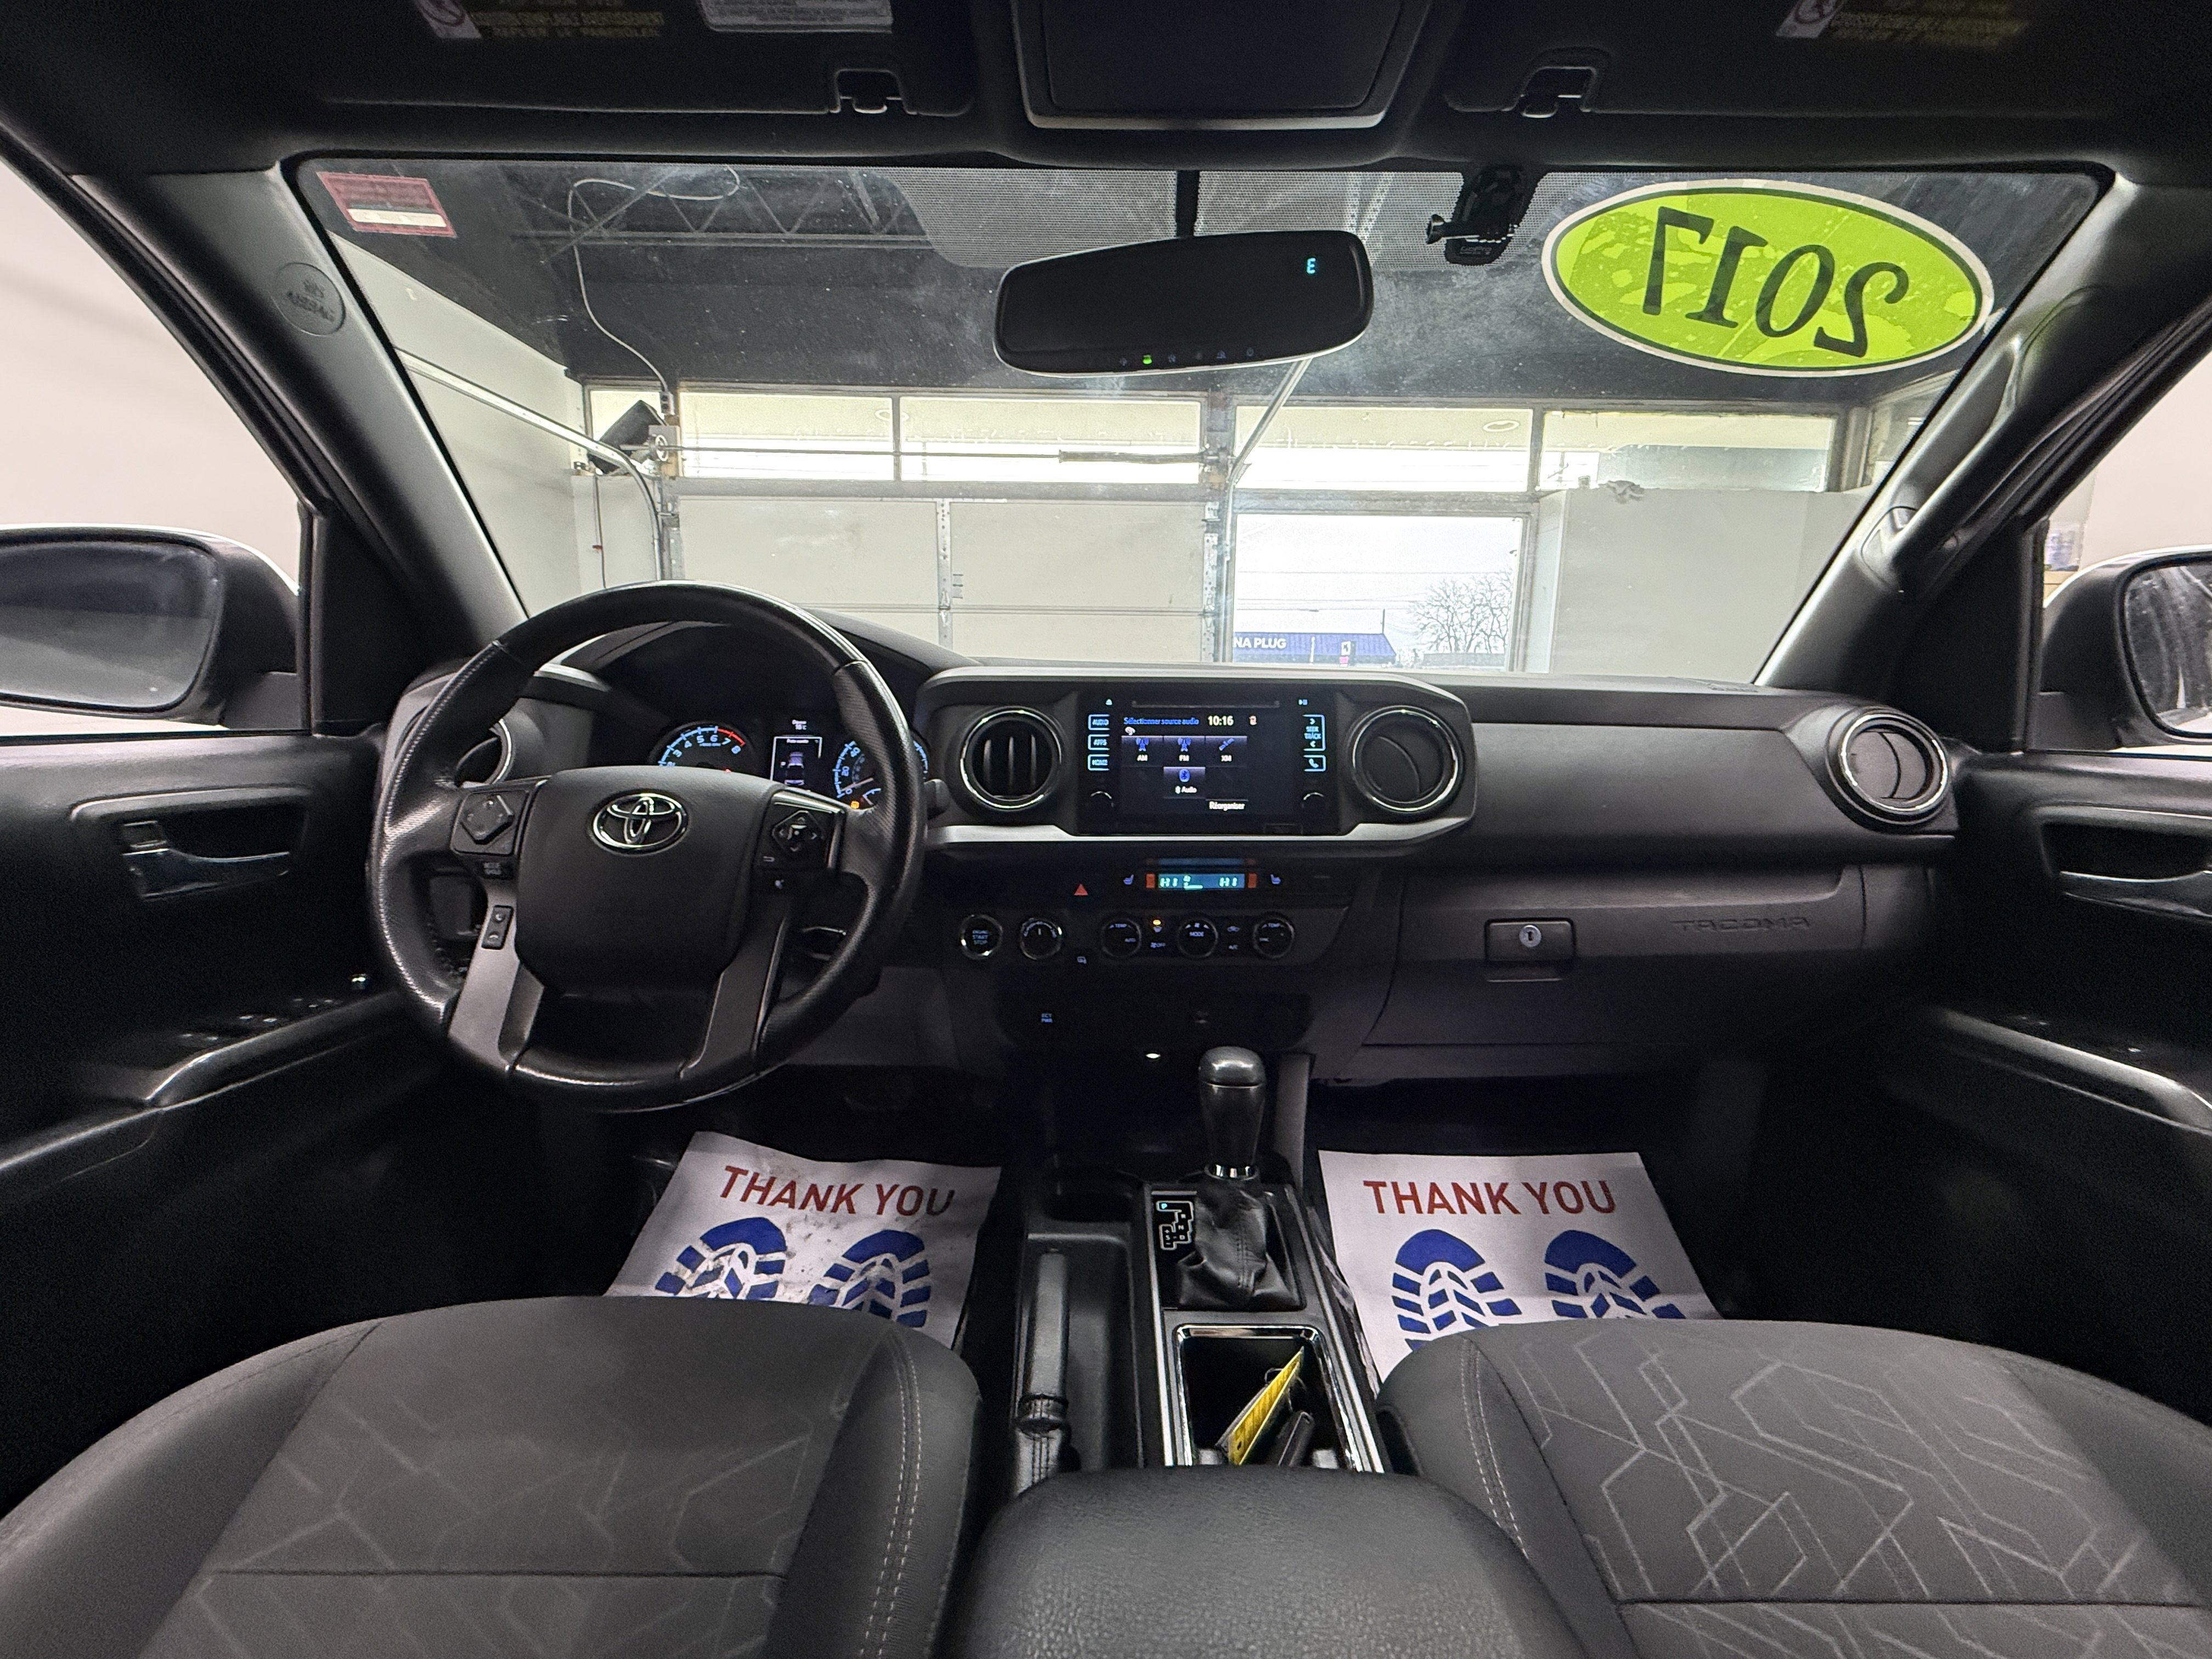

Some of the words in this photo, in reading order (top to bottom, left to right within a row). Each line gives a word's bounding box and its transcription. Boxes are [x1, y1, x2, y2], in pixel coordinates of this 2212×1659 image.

[1307, 258, 1316, 274] E
[1254, 638, 1286, 648] PLUG
[1207, 715, 1234, 726] 10:16
[684, 740, 692, 748] 4
[696, 735, 705, 743] 5
[673, 749, 682, 758] 3
[731, 746, 741, 754] 8
[841, 766, 850, 776] 20
[1669, 917, 1810, 931] TACOMA
[720, 1165, 864, 1214] THANK
[875, 1184, 956, 1216] YOU
[1363, 1180, 1521, 1215] THANK
[1521, 1180, 1616, 1214] YOU
